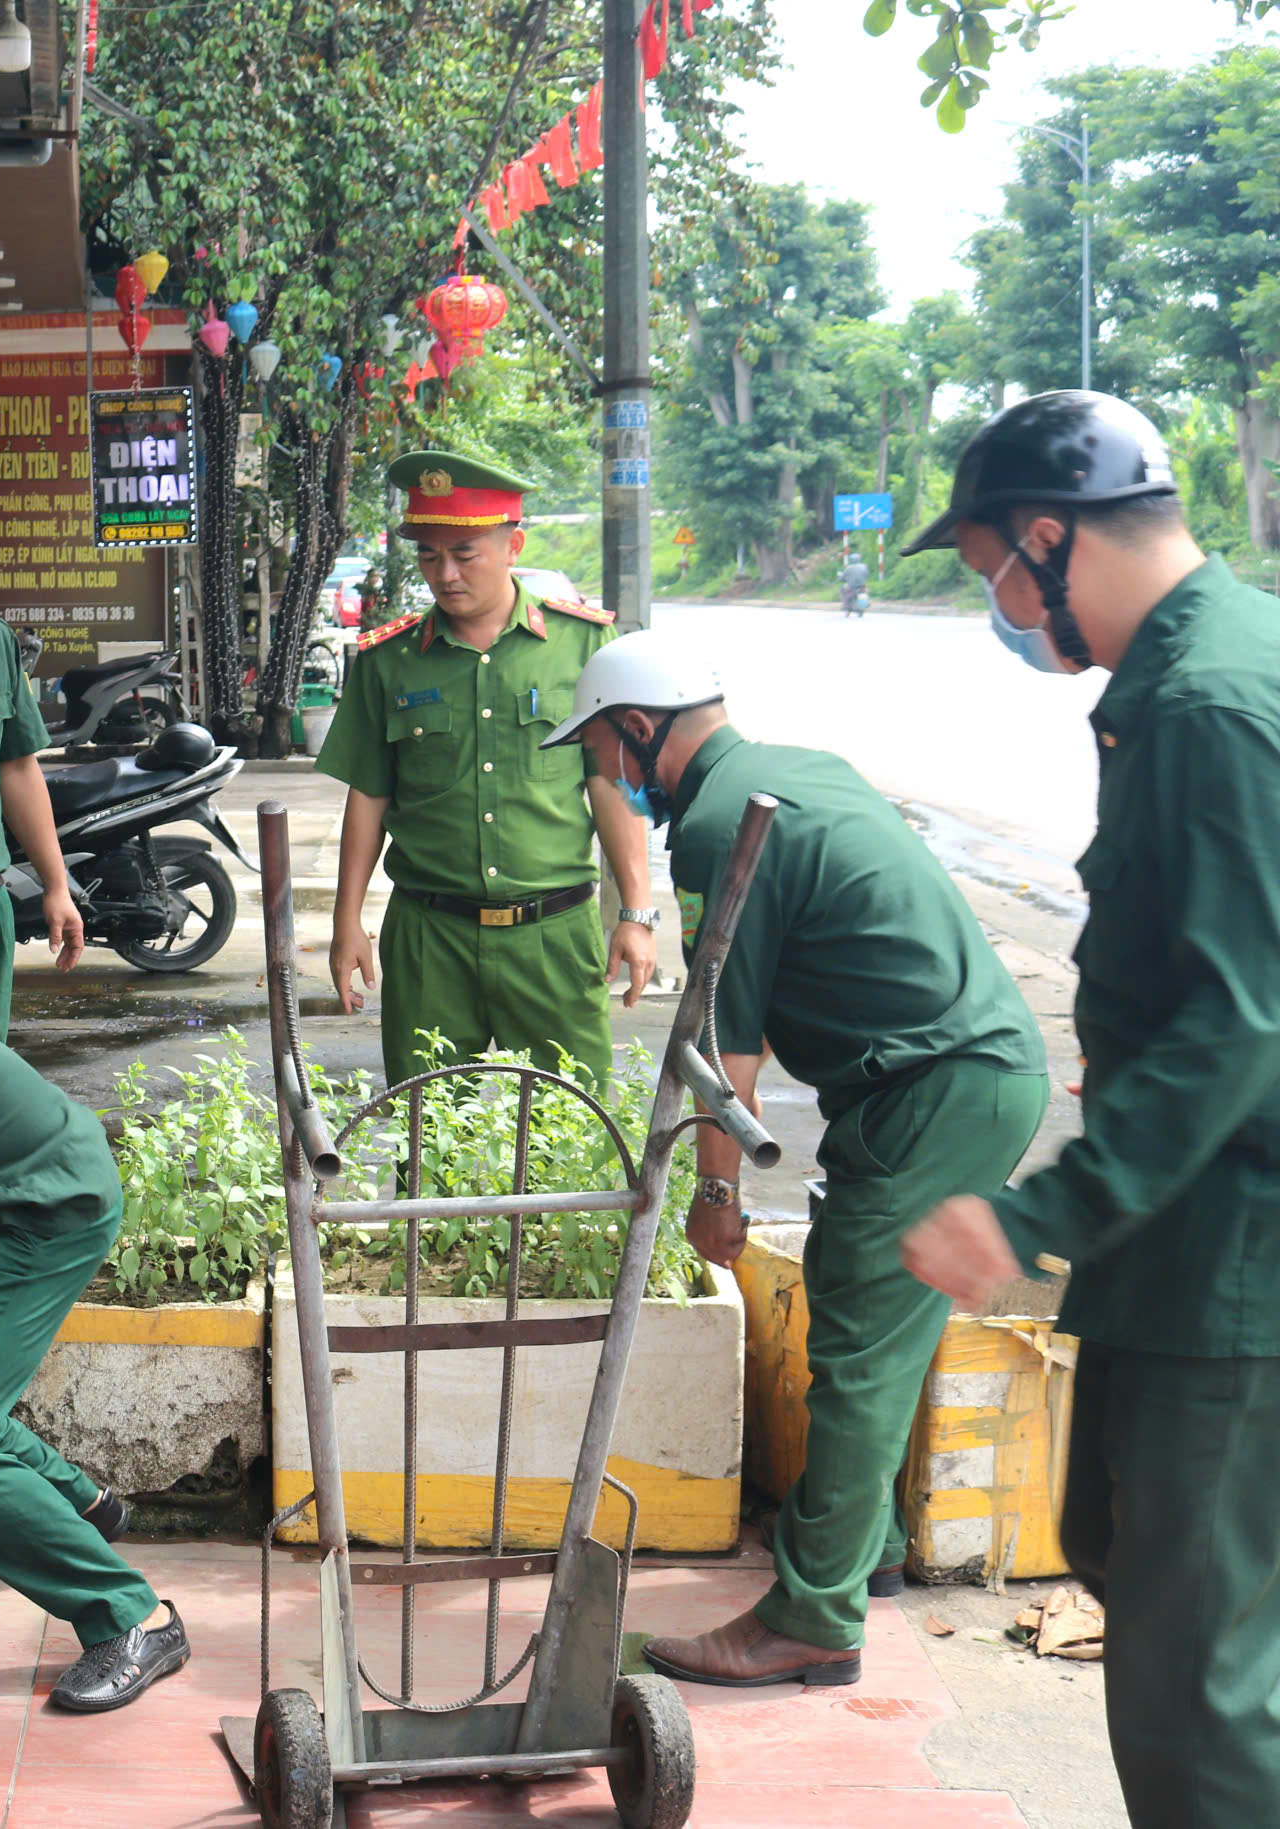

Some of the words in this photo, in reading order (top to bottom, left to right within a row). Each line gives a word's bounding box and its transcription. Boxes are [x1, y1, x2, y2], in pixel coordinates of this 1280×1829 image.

[25, 440, 59, 480] TIỀN
[109, 435, 177, 472] ĐIỆN
[99, 474, 189, 507] THOẠI
[5, 517, 31, 537] CÔNG
[17, 543, 30, 563] ÉP
[55, 541, 73, 563] LẤY
[57, 568, 82, 589] KHÓA
[84, 570, 118, 588] ICLOUD
[4, 607, 27, 621] 0375
[47, 607, 65, 621] 334
[72, 606, 95, 621] 0835
[43, 642, 52, 652] P.
